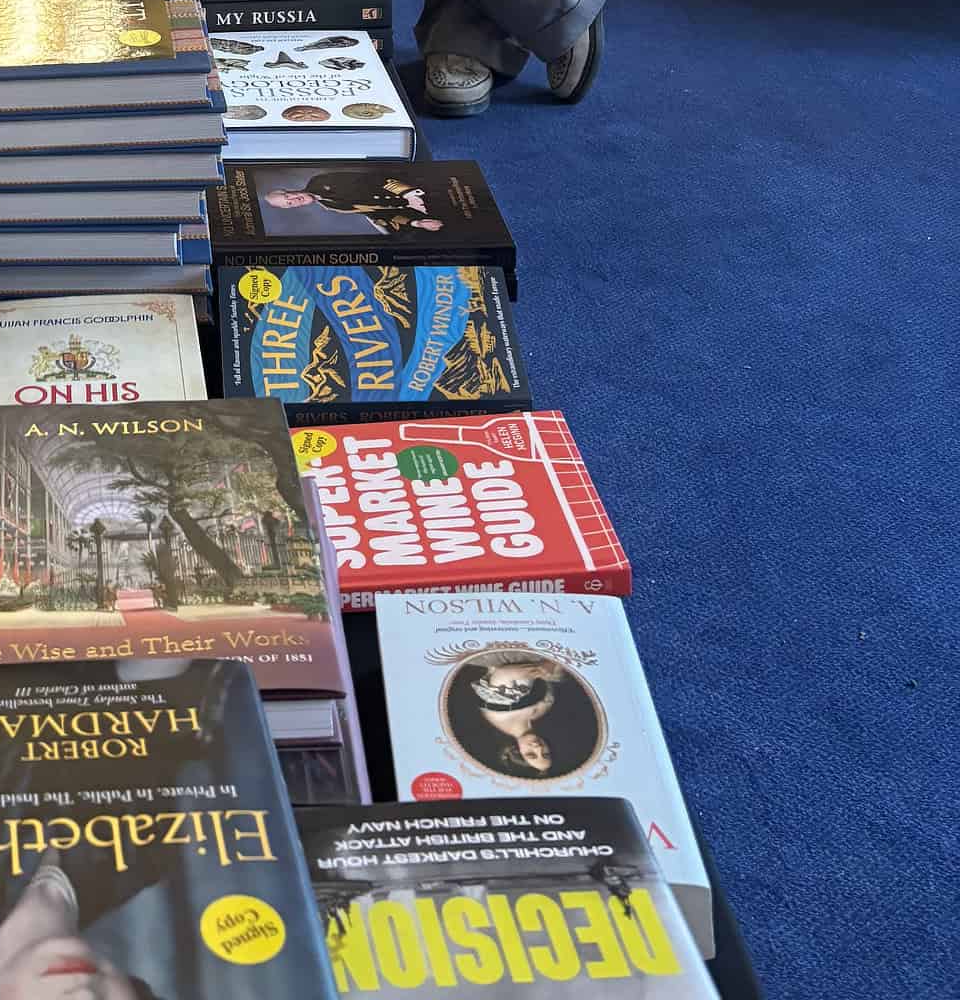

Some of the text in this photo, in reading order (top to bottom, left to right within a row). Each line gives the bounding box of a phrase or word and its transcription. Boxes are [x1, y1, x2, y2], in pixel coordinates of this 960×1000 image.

[216, 10, 316, 25] MY RUSSIA
[232, 88, 357, 98] FOSSILS
[224, 253, 378, 266] NO UNCERTAIN SOUND
[249, 275, 258, 300] Signed
[261, 278, 272, 298] Copy
[34, 315, 154, 327] FRANCIS GODOLPHIN
[317, 275, 394, 390] RIVERS
[408, 274, 456, 393] ROBERT WINDER
[261, 295, 308, 397] THREE
[14, 382, 140, 404] ON HIS
[25, 418, 203, 437] A. N. WILSON
[299, 432, 312, 455] Signed
[312, 436, 327, 454] Copy
[497, 426, 513, 450] HELEN
[343, 436, 428, 566] MARKET
[464, 459, 544, 558] GUIDE
[412, 477, 486, 564] WINE
[511, 579, 565, 593] GUIDE
[405, 599, 595, 615] A. N. WILSON
[10, 642, 76, 660] Wise
[85, 640, 133, 658] and
[142, 635, 215, 656] Their
[260, 653, 313, 663] OF 1851
[16, 682, 137, 697] author of Charles III
[141, 694, 167, 704] The
[57, 696, 92, 706] Times
[98, 695, 137, 706] Sunday
[21, 737, 149, 762] ROBERT
[45, 791, 74, 806] The
[79, 790, 132, 803] Public.
[139, 789, 154, 801] In
[158, 786, 217, 799] Private.
[221, 786, 238, 797] In
[348, 814, 565, 834] ON THE FRENCH NAVY
[335, 830, 586, 851] AND THE BRITISH ATTACK
[317, 844, 613, 869] CHURCHILL'S DARKEST HOUR
[215, 909, 260, 931] Copy
[222, 921, 279, 954] Signed
[327, 889, 682, 992] DECISION
